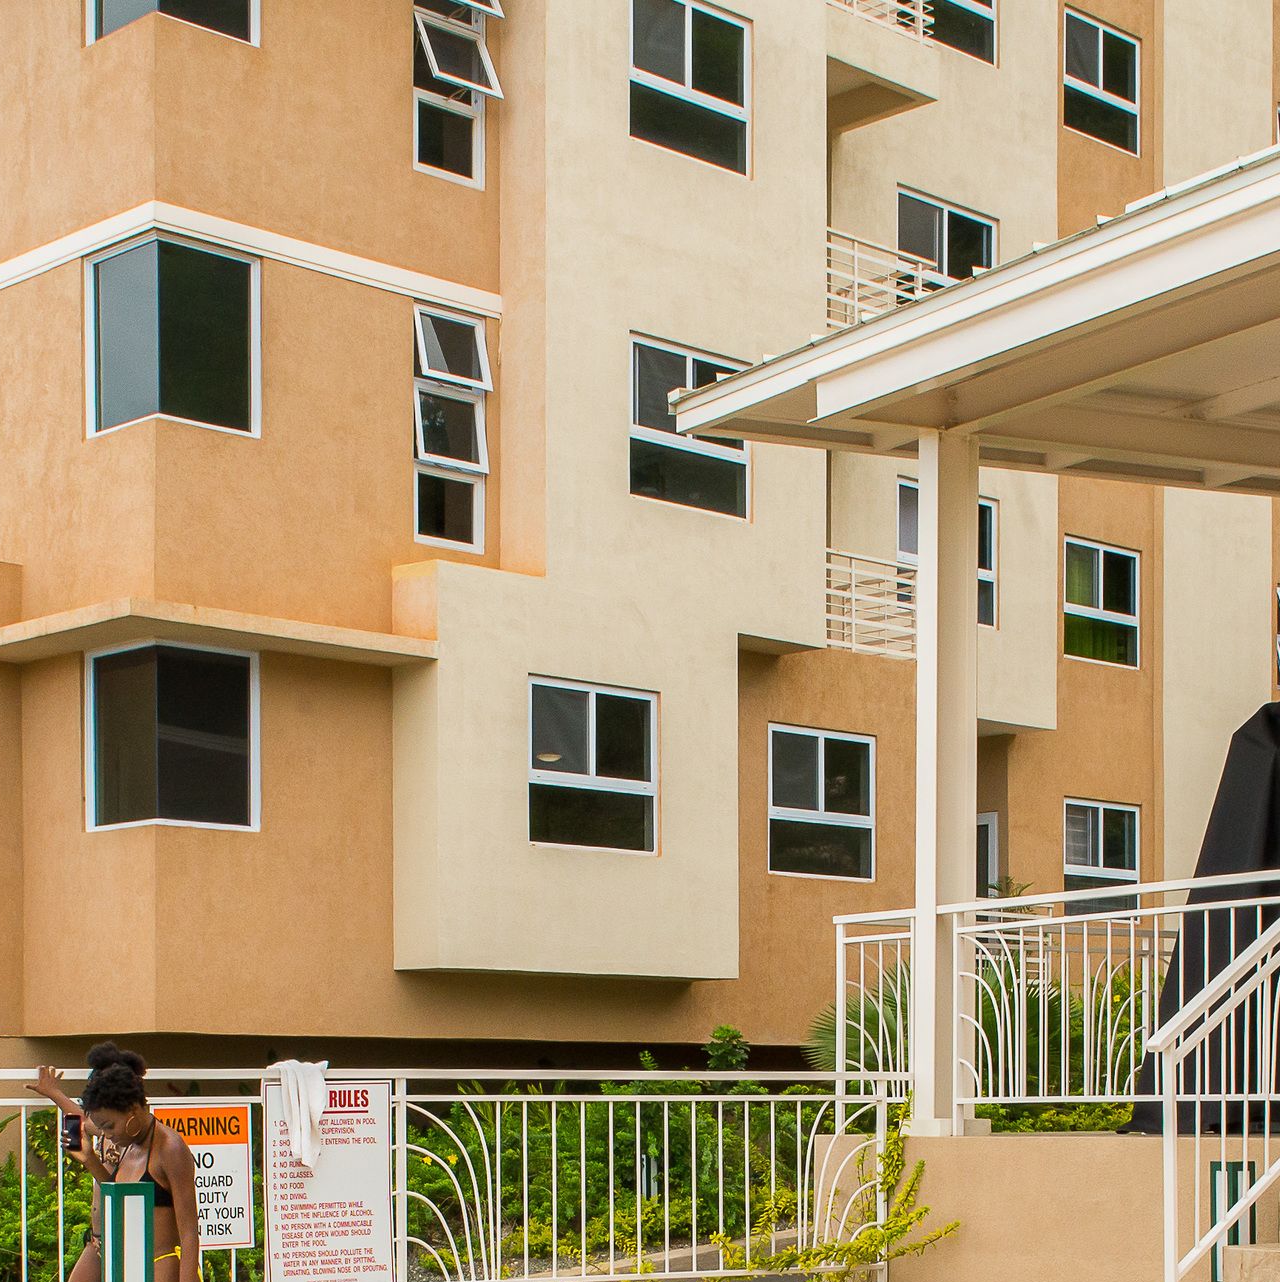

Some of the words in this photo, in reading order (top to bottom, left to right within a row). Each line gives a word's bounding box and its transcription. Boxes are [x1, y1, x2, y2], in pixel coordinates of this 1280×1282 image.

[329, 1089, 369, 1108] RULES
[331, 1118, 354, 1126] ALLOWED
[363, 1117, 377, 1125] POOL
[325, 1138, 350, 1146] ENTERING
[352, 1137, 361, 1145] THE
[363, 1136, 377, 1144] POOL
[279, 1150, 288, 1158] NO
[199, 1191, 229, 1204] DUTY
[280, 1193, 289, 1201] NO
[290, 1203, 317, 1211] SWIMMING
[318, 1201, 347, 1210] PERMITTED
[348, 1201, 364, 1209] WHILE
[197, 1208, 210, 1220] AT
[214, 1207, 245, 1220] YOUR
[281, 1212, 299, 1220] UNDER
[312, 1210, 339, 1218] INFLUENCE
[206, 1223, 233, 1236] RISK
[291, 1222, 312, 1231] PERSON
[313, 1222, 327, 1230] WITH
[333, 1220, 373, 1229] COMMUNICABLE
[282, 1231, 304, 1240] DISEASE
[306, 1231, 313, 1239] OR
[315, 1230, 329, 1238] OPEN
[330, 1229, 350, 1238] WOUND
[351, 1228, 372, 1237] SHOULD
[282, 1241, 299, 1249] ENTER
[301, 1240, 311, 1248] THE
[282, 1252, 291, 1260] NO
[292, 1250, 317, 1259] PERSONS
[318, 1249, 339, 1258] SHOULD
[340, 1248, 362, 1257] POLLUTE
[364, 1247, 373, 1255] THE
[283, 1260, 300, 1268] WATER
[301, 1259, 308, 1267] IN
[309, 1258, 319, 1266] ANY
[344, 1257, 351, 1265] BY
[312, 1267, 336, 1275] BLOWING
[337, 1266, 352, 1274] NOSE
[353, 1265, 361, 1273] OR
